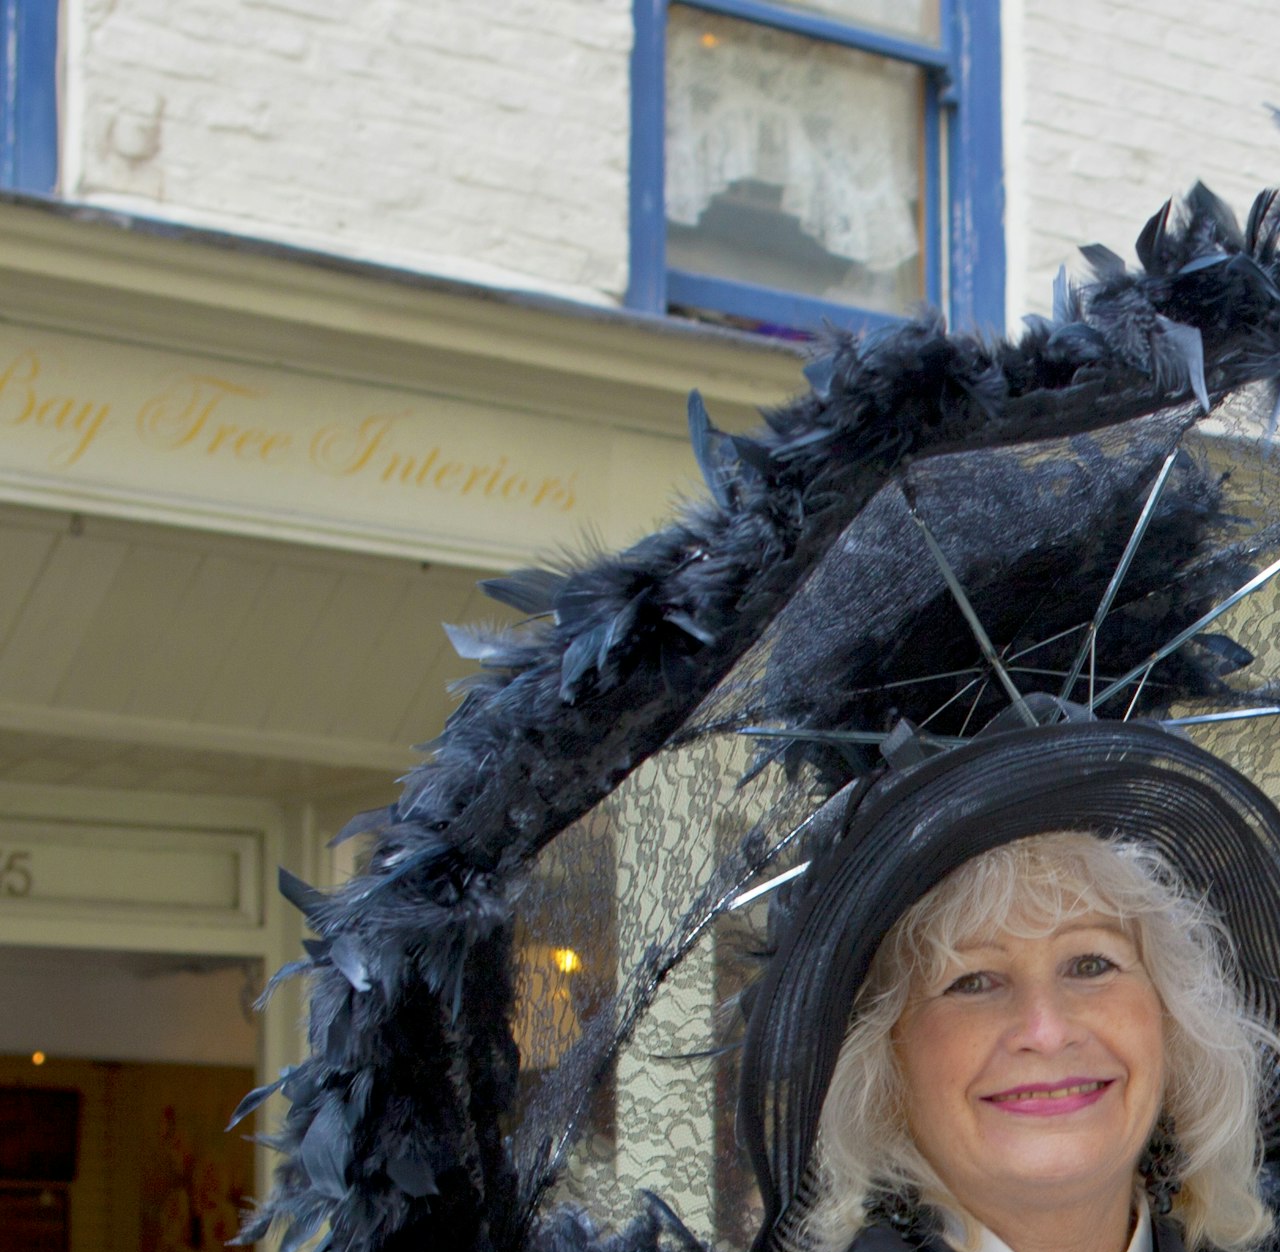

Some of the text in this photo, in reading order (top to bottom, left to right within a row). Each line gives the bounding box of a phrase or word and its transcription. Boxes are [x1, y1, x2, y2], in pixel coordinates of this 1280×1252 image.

[0, 349, 578, 511] Bay Tree Interiors
[0, 850, 32, 898] 5
